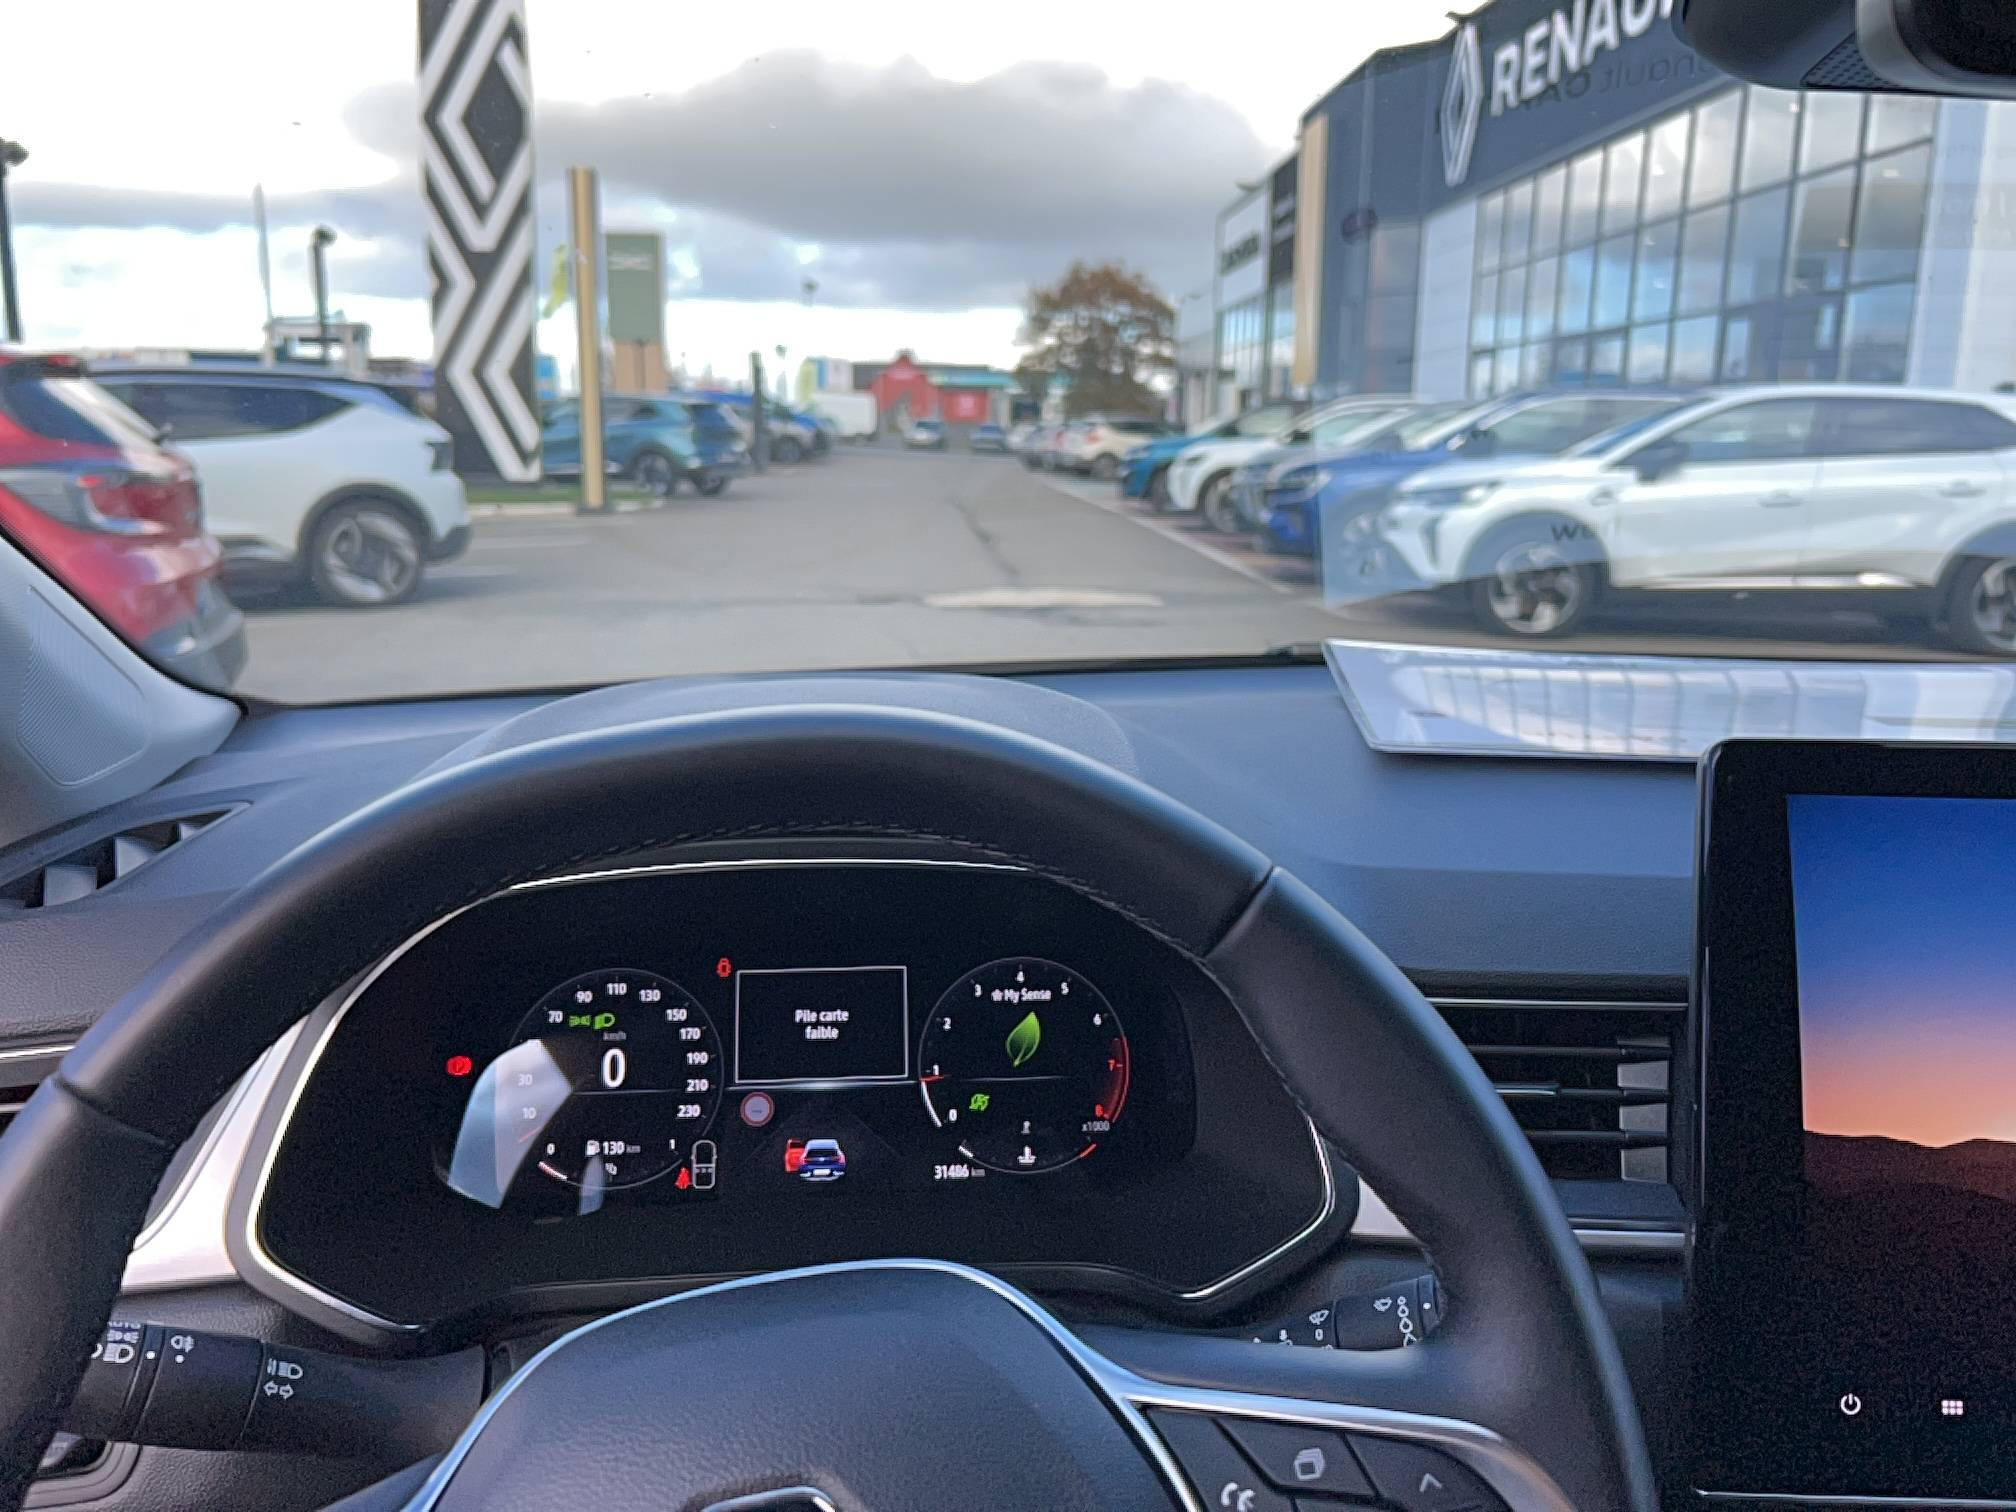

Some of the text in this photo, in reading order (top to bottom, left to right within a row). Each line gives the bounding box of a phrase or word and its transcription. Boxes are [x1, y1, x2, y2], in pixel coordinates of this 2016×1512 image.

[1016, 971, 1024, 983] 4
[607, 983, 627, 995] 110
[973, 984, 981, 997] 3
[1060, 982, 1069, 994] 5
[576, 991, 593, 1003] 90
[639, 990, 661, 1002] 130
[1004, 987, 1051, 1004] My Sense
[548, 1010, 563, 1023] 70
[666, 1008, 687, 1021] 150
[795, 1009, 849, 1023] Pile carte
[1093, 1014, 1101, 1026] 6
[943, 1018, 951, 1030] 2
[680, 1027, 701, 1040] 170
[805, 1026, 839, 1040] faible
[686, 1052, 708, 1065] 190
[1107, 1059, 1115, 1070] 7
[602, 1048, 627, 1088] 0
[933, 1064, 940, 1075] 1
[517, 1074, 532, 1086] 30
[686, 1079, 708, 1092] 210
[522, 1107, 536, 1119] 10
[677, 1105, 701, 1118] 230
[949, 1108, 957, 1121] 0
[546, 1143, 555, 1155] 0
[602, 1141, 625, 1155] 130
[669, 1139, 675, 1150] 1
